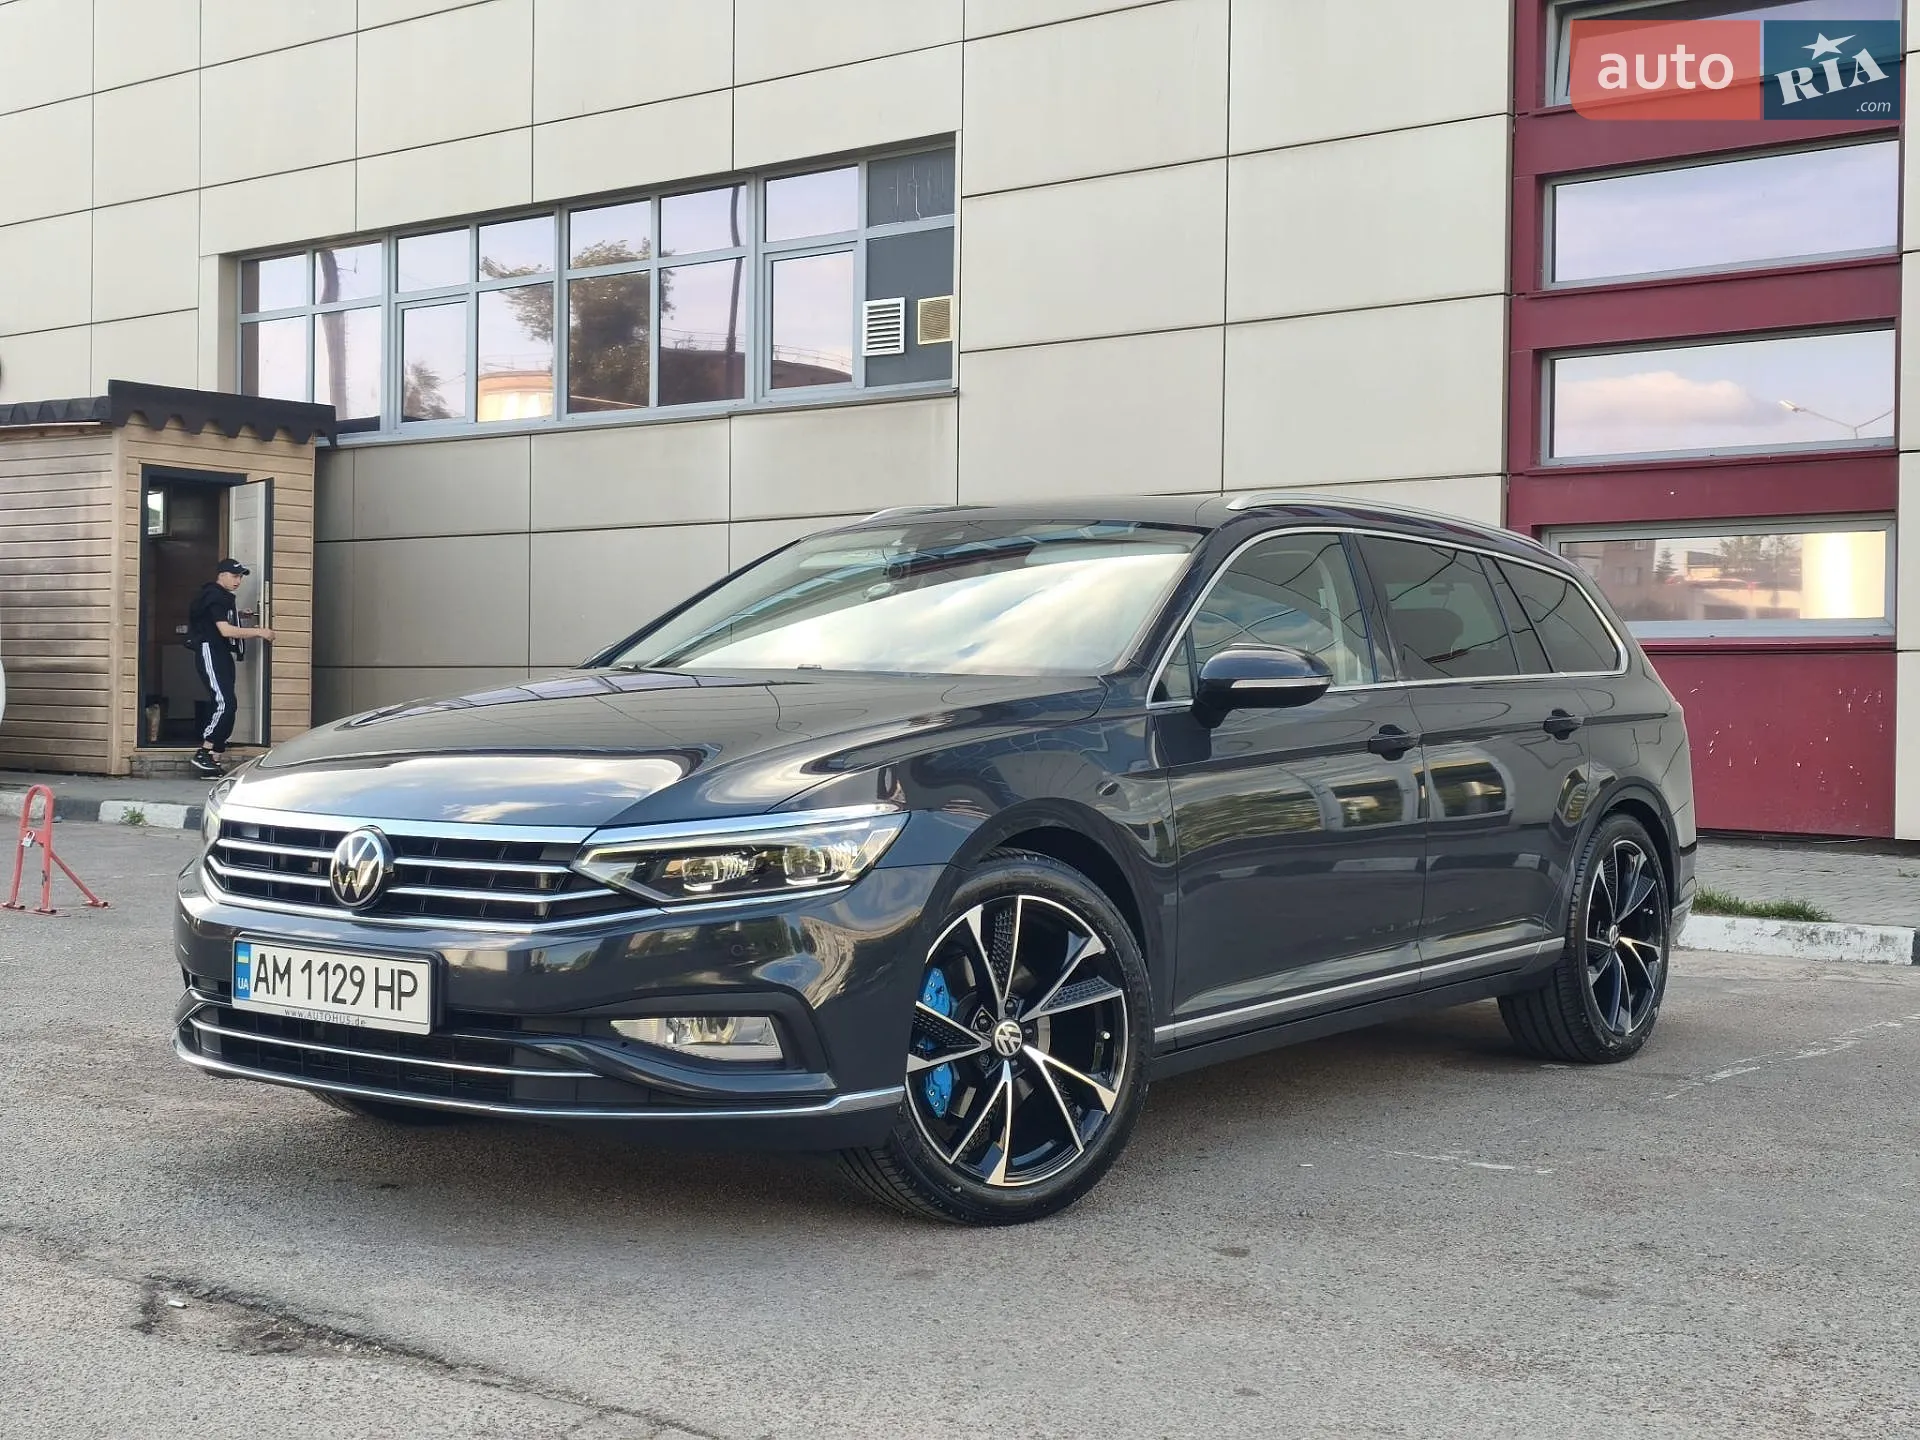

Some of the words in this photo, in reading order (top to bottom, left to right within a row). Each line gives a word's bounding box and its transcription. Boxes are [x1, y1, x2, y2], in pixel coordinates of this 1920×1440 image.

[237, 977, 249, 991] UA
[253, 953, 292, 997] AM
[300, 959, 366, 1006] 1129
[374, 967, 418, 1011] HP
